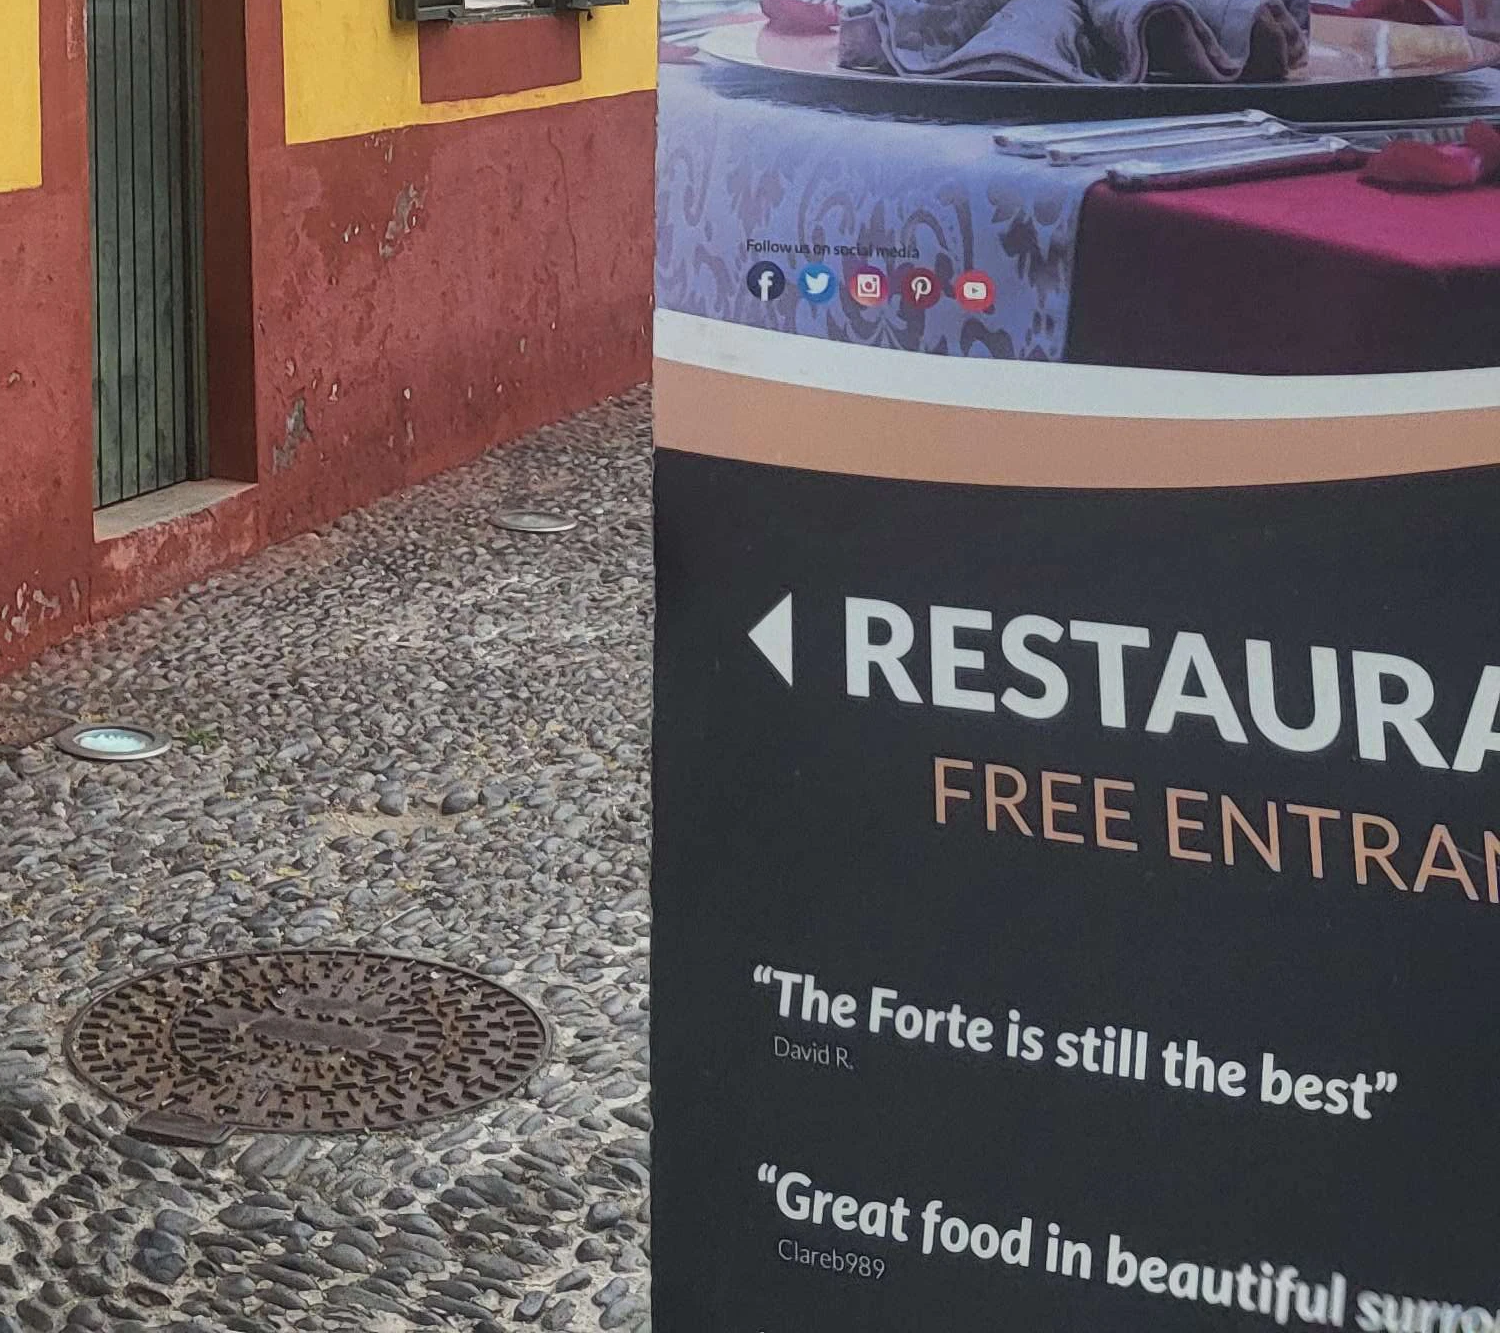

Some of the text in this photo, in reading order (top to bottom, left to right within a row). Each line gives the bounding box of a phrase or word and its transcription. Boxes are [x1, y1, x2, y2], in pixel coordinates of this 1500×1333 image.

[746, 238, 920, 259] Follow us on social media
[934, 756, 1500, 904] FREE ENTRA
[753, 963, 1398, 1120] “The Forte is still the best”
[773, 1035, 854, 1070] David R.
[757, 1162, 911, 1243] “Great
[920, 1199, 1033, 1268] food
[1045, 1222, 1093, 1280] in
[1106, 1233, 1348, 1327] beautiful
[777, 1238, 886, 1280] Clareb989
